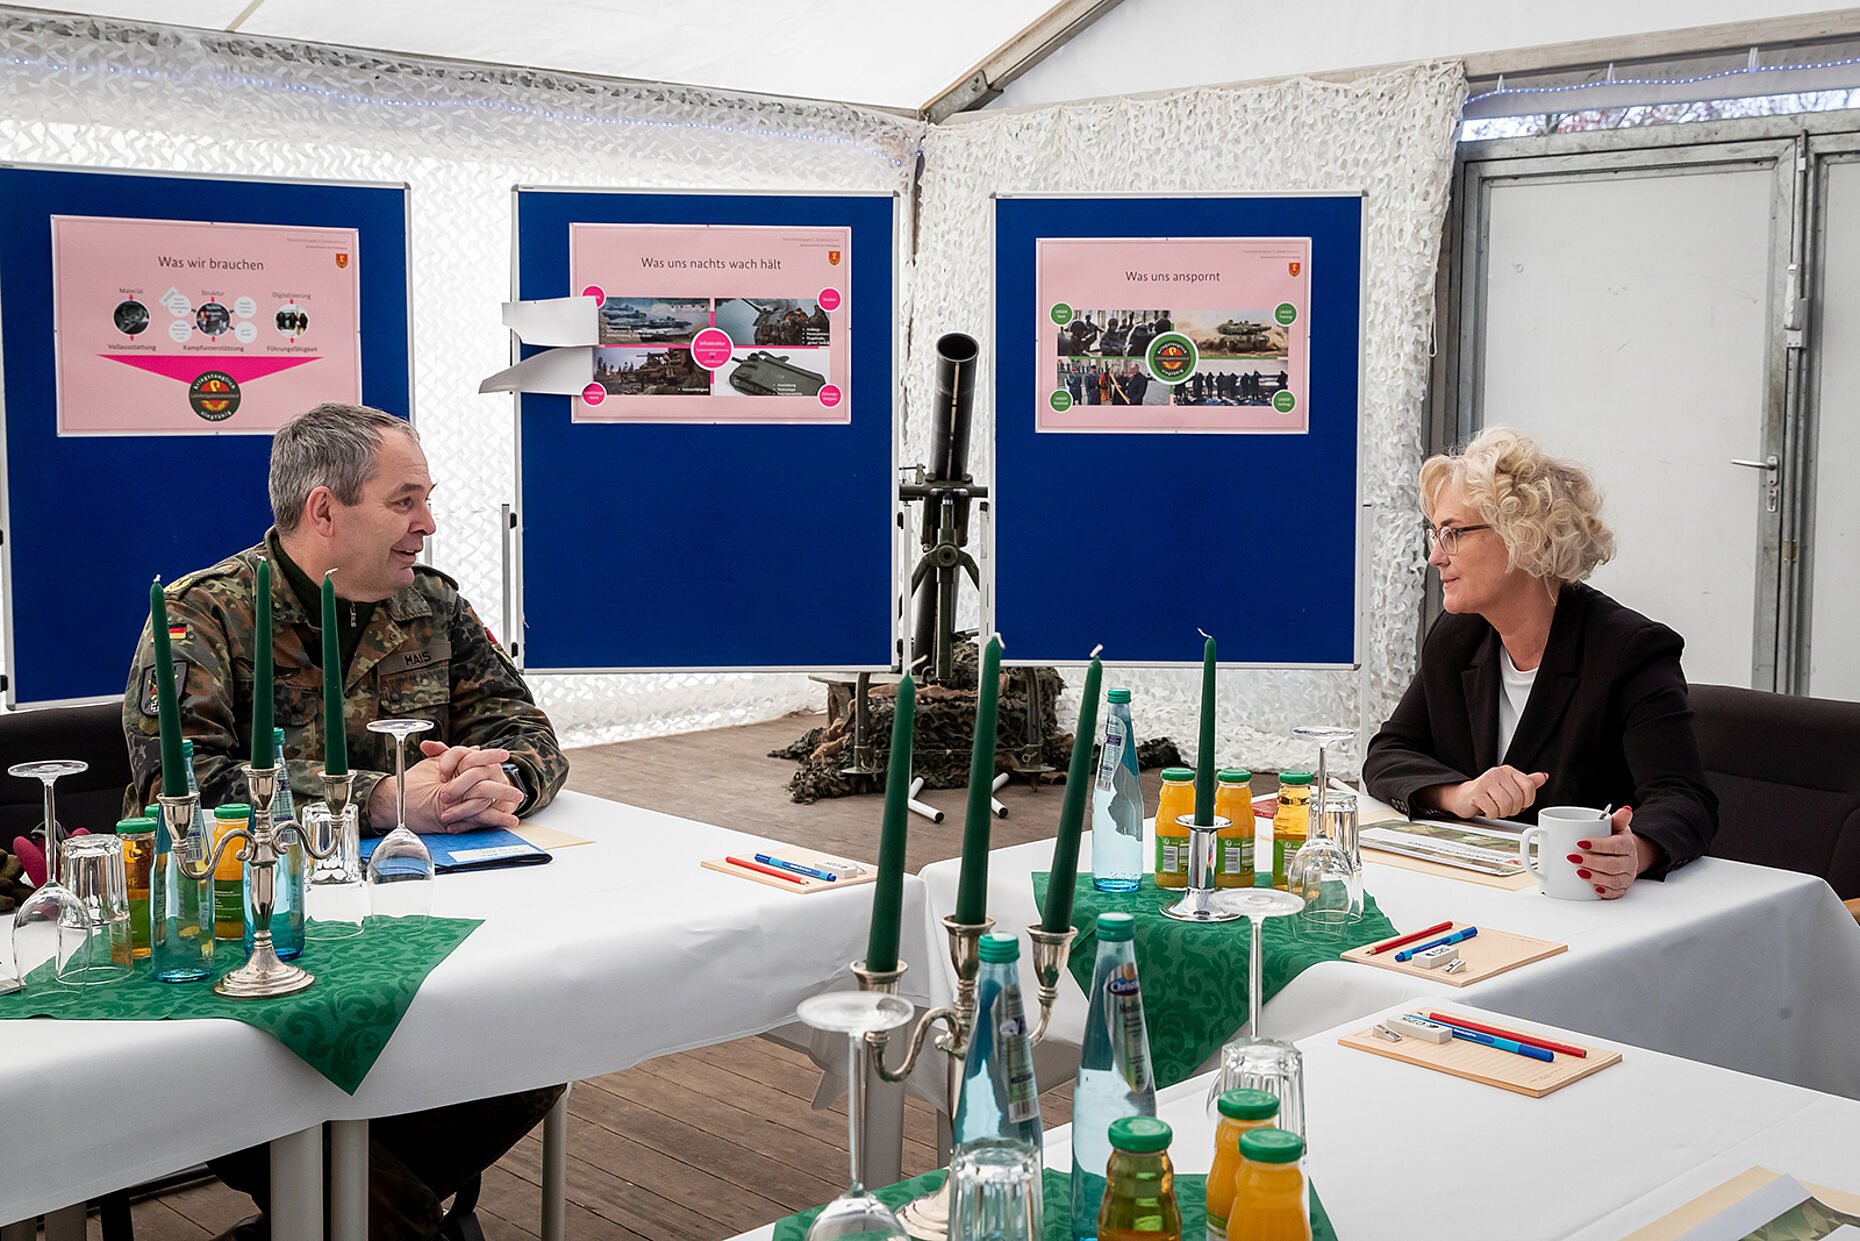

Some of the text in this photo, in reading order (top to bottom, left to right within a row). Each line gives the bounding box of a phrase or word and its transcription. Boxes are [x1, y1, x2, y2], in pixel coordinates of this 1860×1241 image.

[158, 256, 264, 270] Was wir brauchen
[641, 257, 782, 269] Was uns nachts wach hält
[1125, 271, 1220, 283] Was uns anspornt
[404, 651, 432, 666] MAIS
